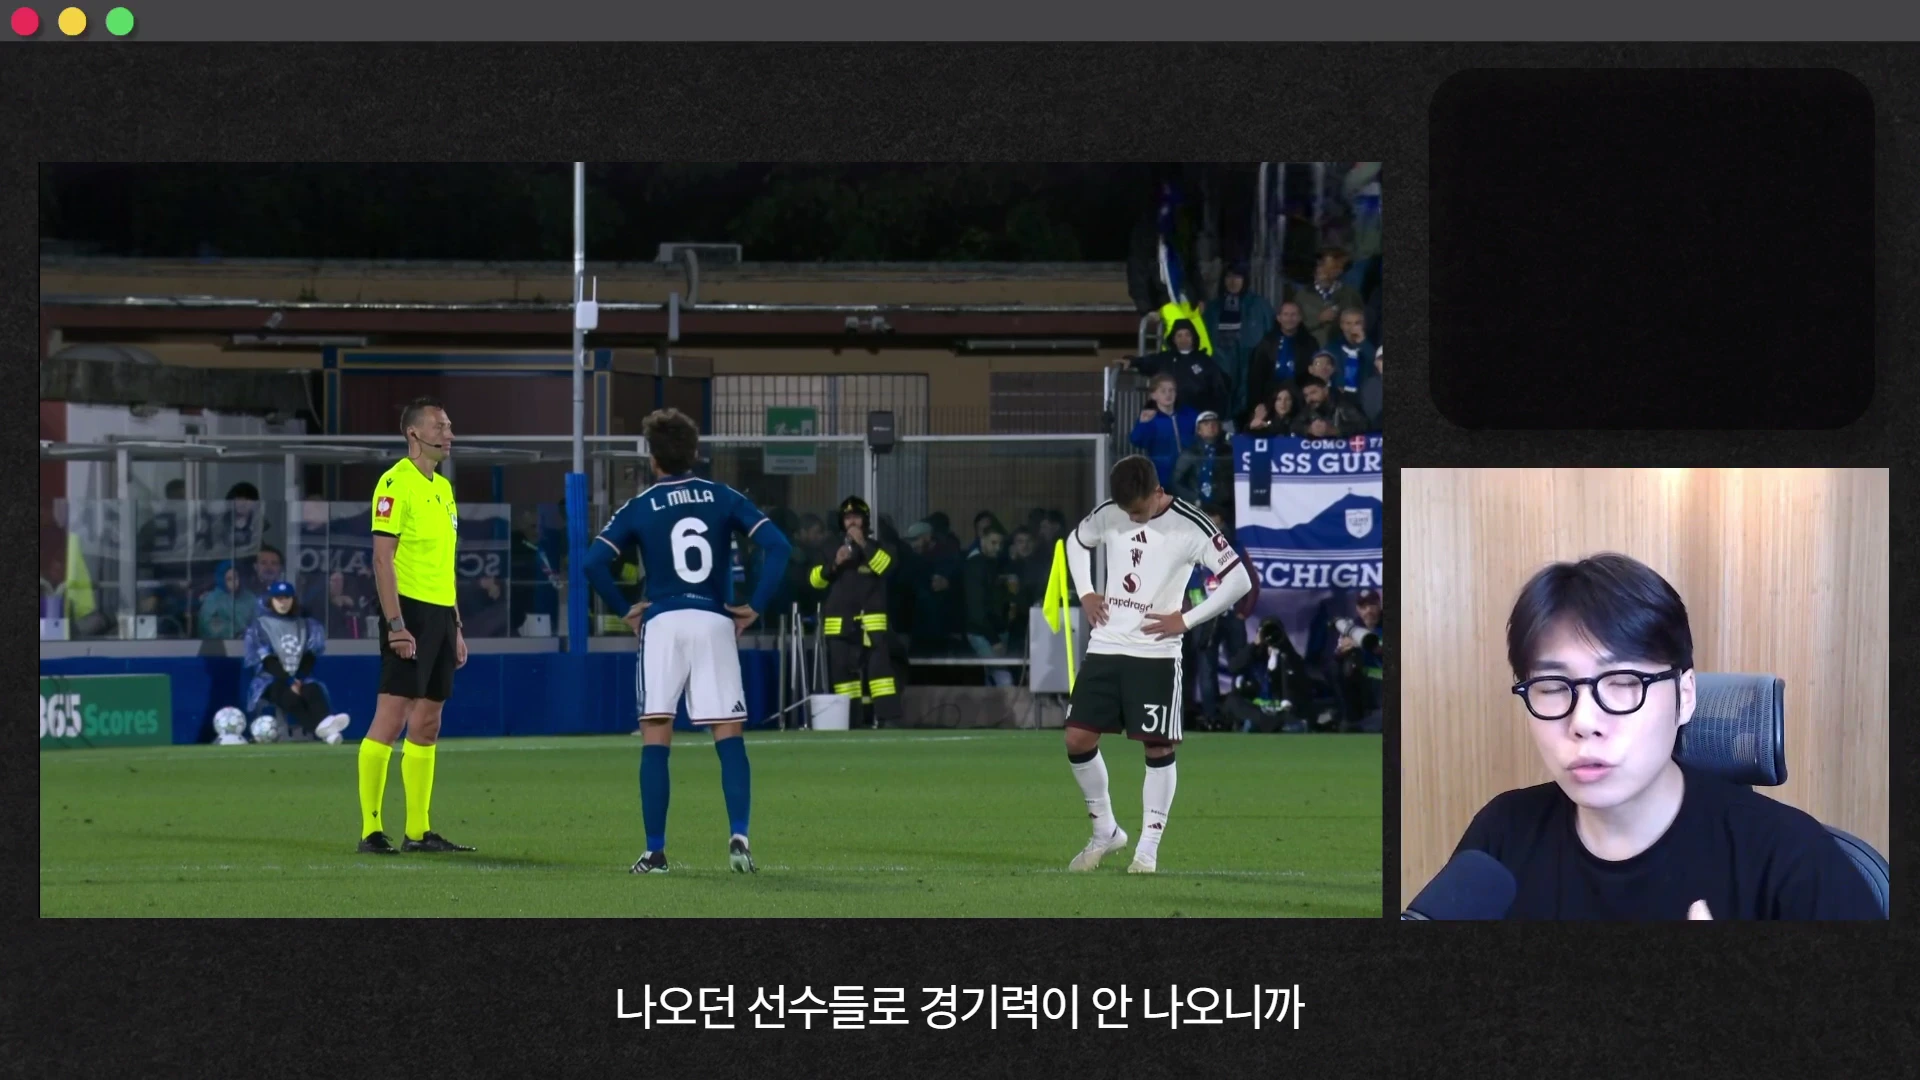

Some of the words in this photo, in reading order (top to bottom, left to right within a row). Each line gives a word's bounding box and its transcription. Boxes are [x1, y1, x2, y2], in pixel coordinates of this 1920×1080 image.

[1300, 438, 1347, 450] COMO
[650, 497, 666, 512] L.
[667, 489, 715, 507] MILLA
[670, 516, 713, 583] 6
[1141, 703, 1168, 735] 31
